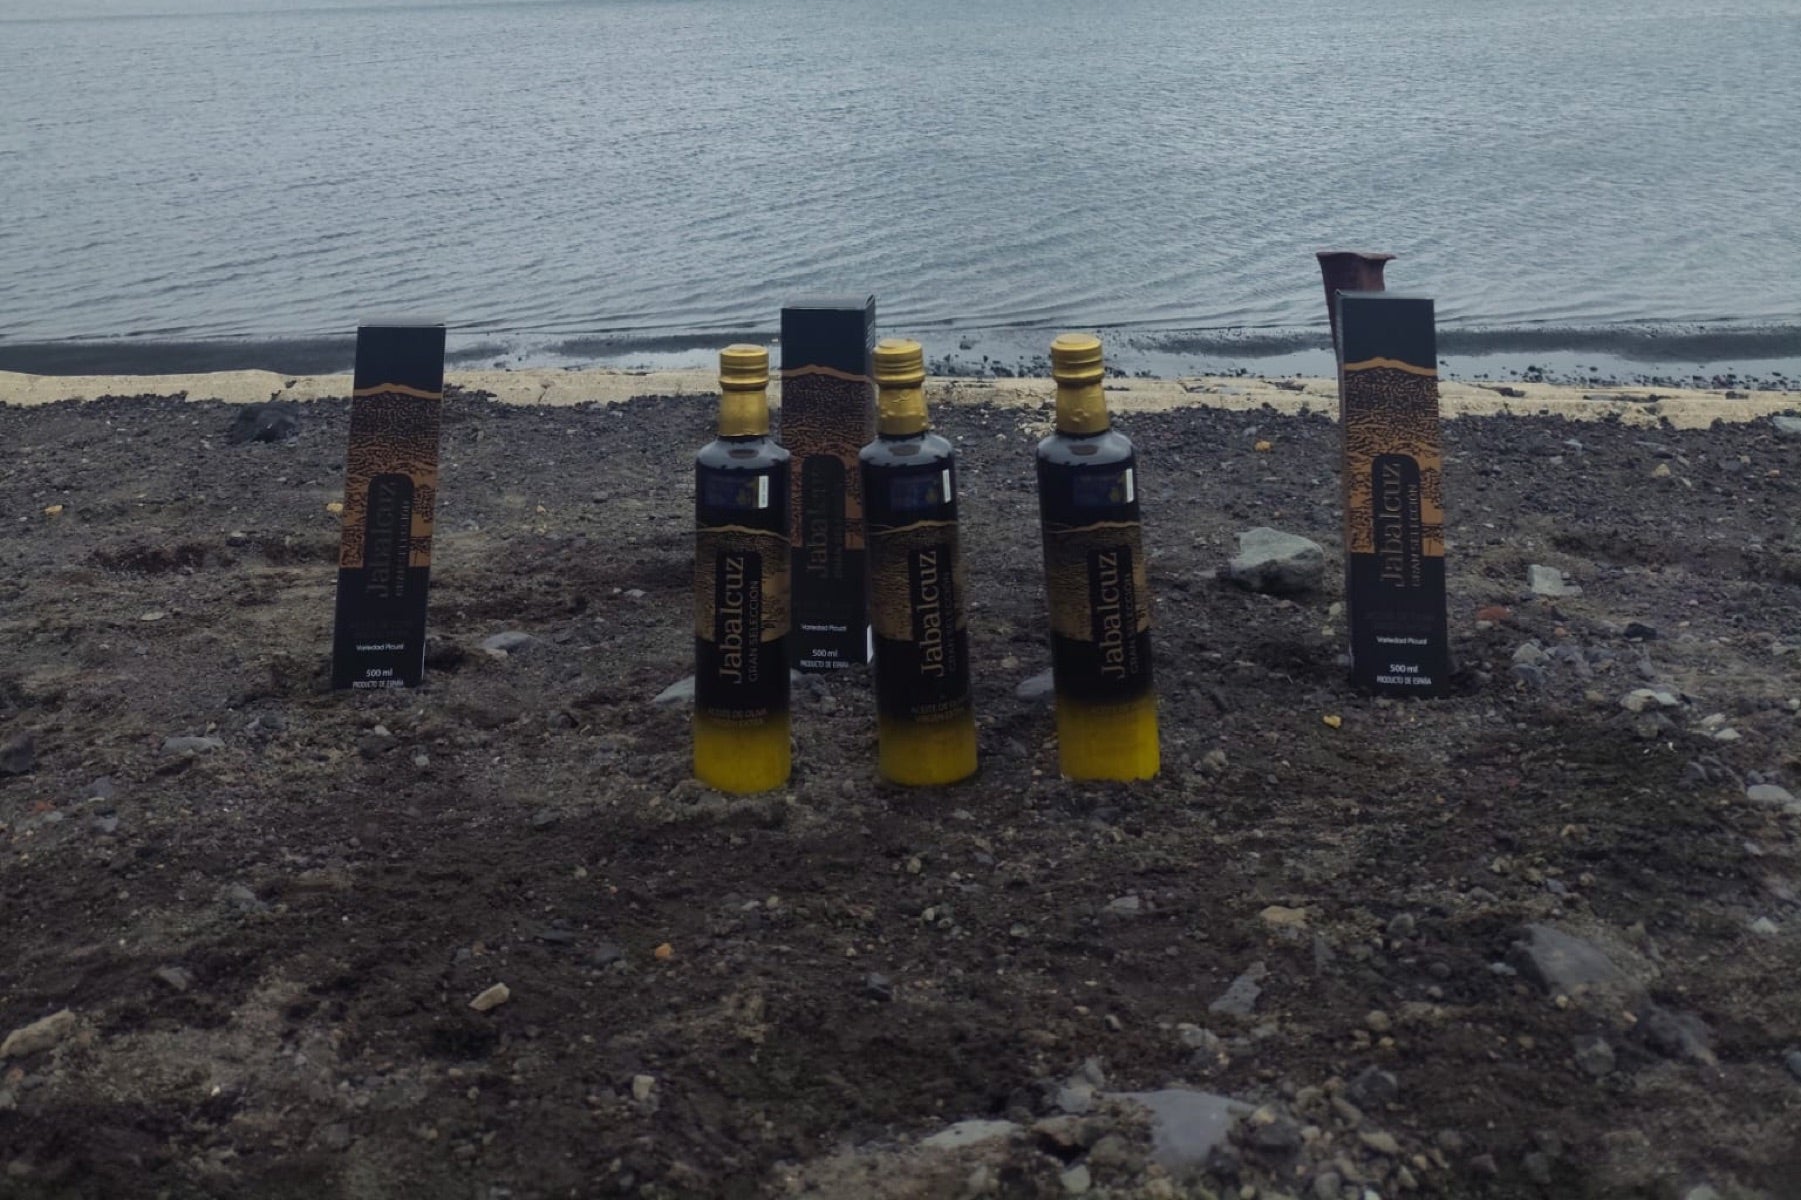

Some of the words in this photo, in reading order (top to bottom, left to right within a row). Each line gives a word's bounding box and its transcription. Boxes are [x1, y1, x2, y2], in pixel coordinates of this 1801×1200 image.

[367, 481, 398, 598] Jabalcuz
[1379, 463, 1405, 588] Jabalcuz
[365, 668, 382, 678] 500
[382, 667, 393, 677] ml
[720, 556, 745, 685] Jabalcuz
[811, 648, 827, 657] 500
[827, 648, 838, 657] ml
[917, 550, 945, 678] Jabalcuz
[1097, 552, 1126, 680] Jabalcuz
[1389, 663, 1406, 673] 500
[1406, 664, 1419, 673] ml
